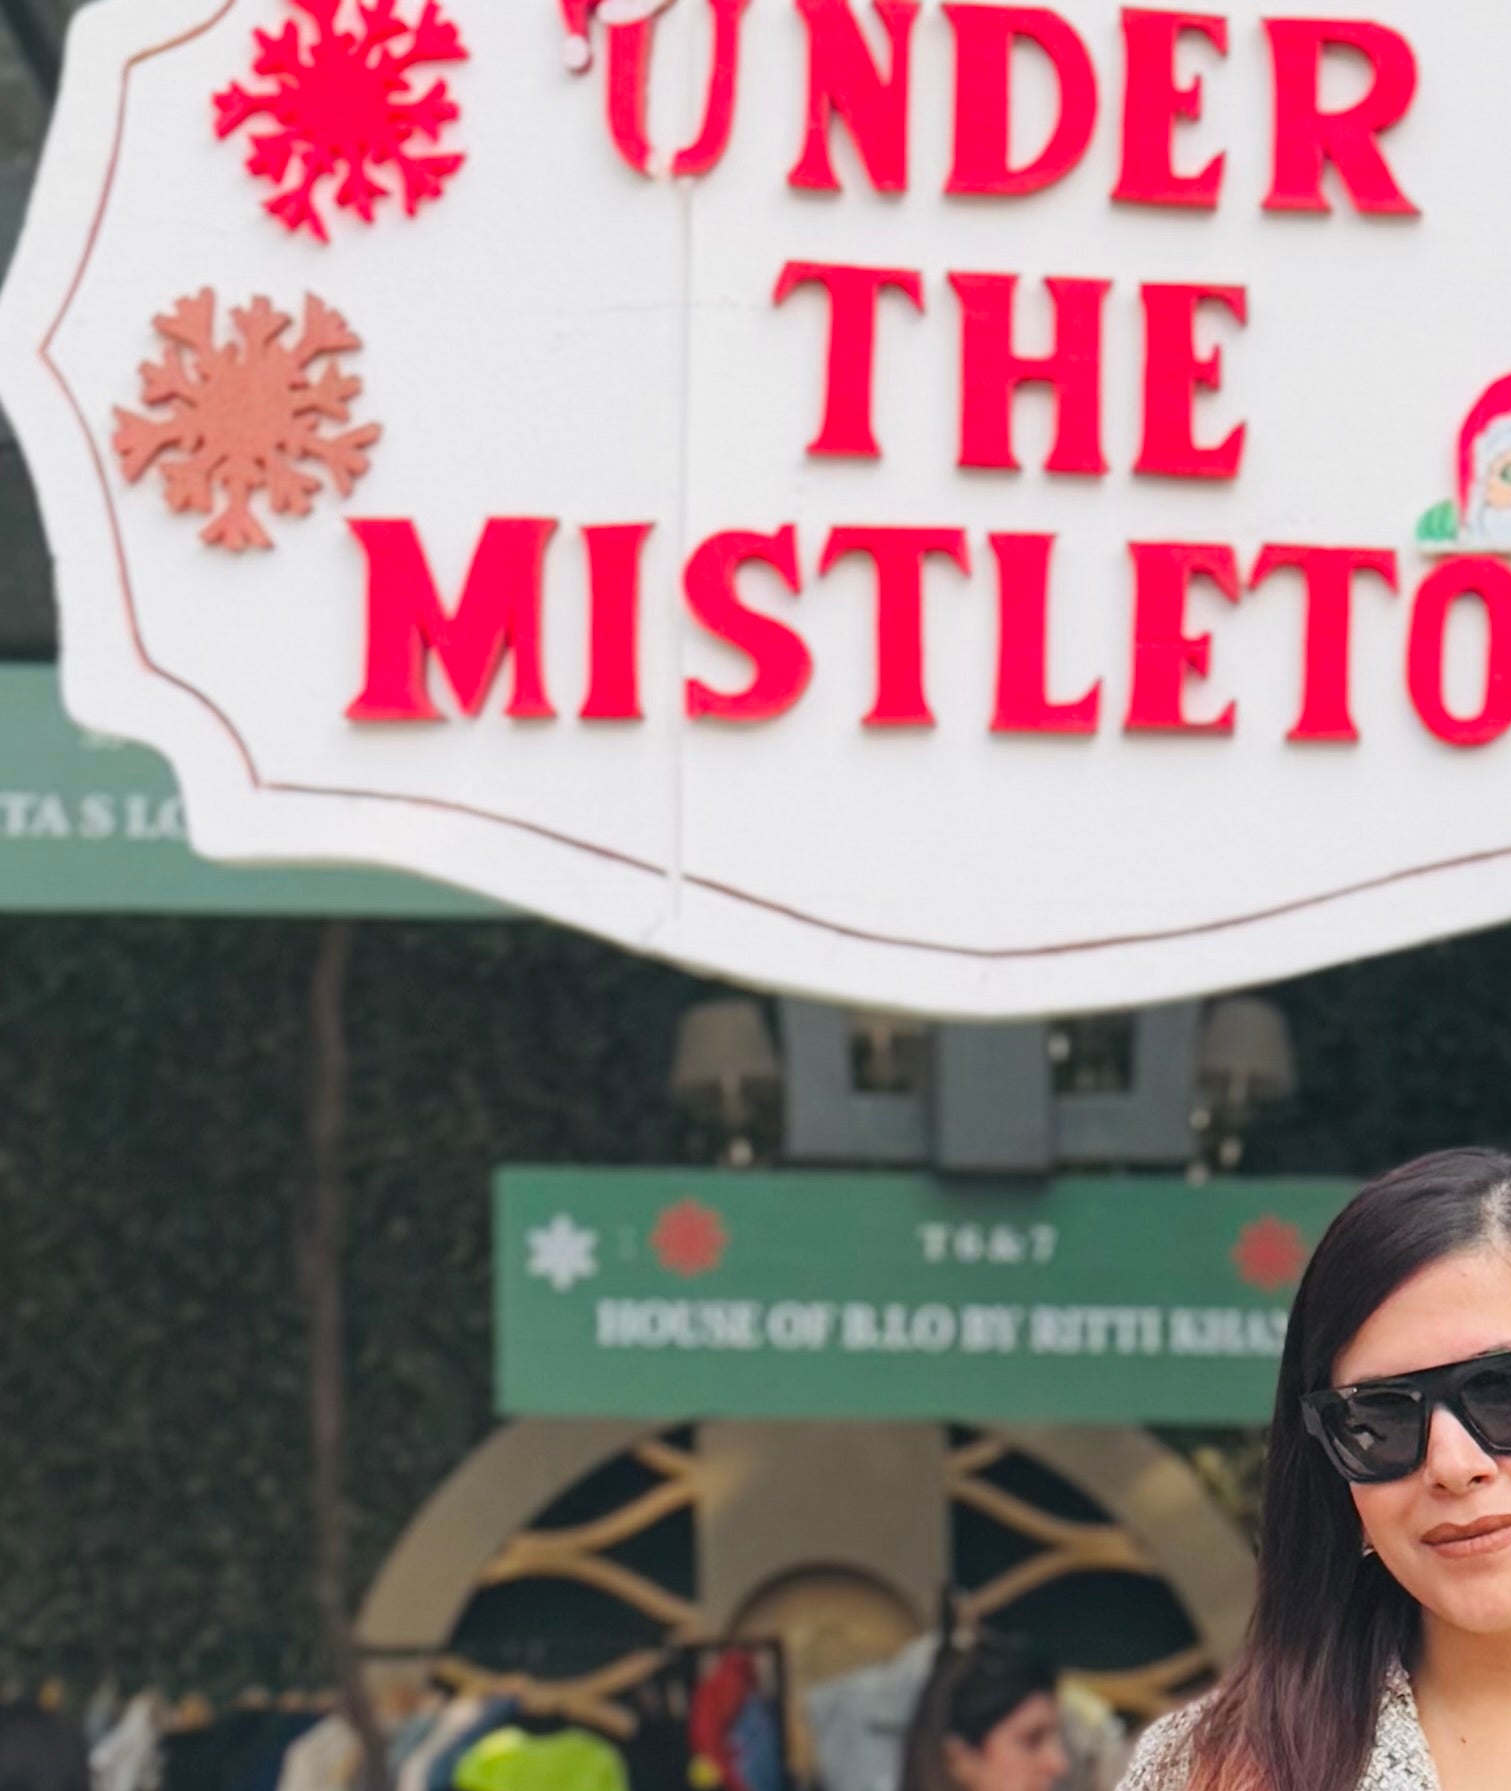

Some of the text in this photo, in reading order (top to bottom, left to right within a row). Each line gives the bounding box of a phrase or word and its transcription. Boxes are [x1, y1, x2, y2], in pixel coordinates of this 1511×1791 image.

[602, 0, 1421, 217] UNDER
[773, 259, 1249, 481] THE
[596, 1298, 762, 1351] HOUSE
[765, 1300, 838, 1351] OF
